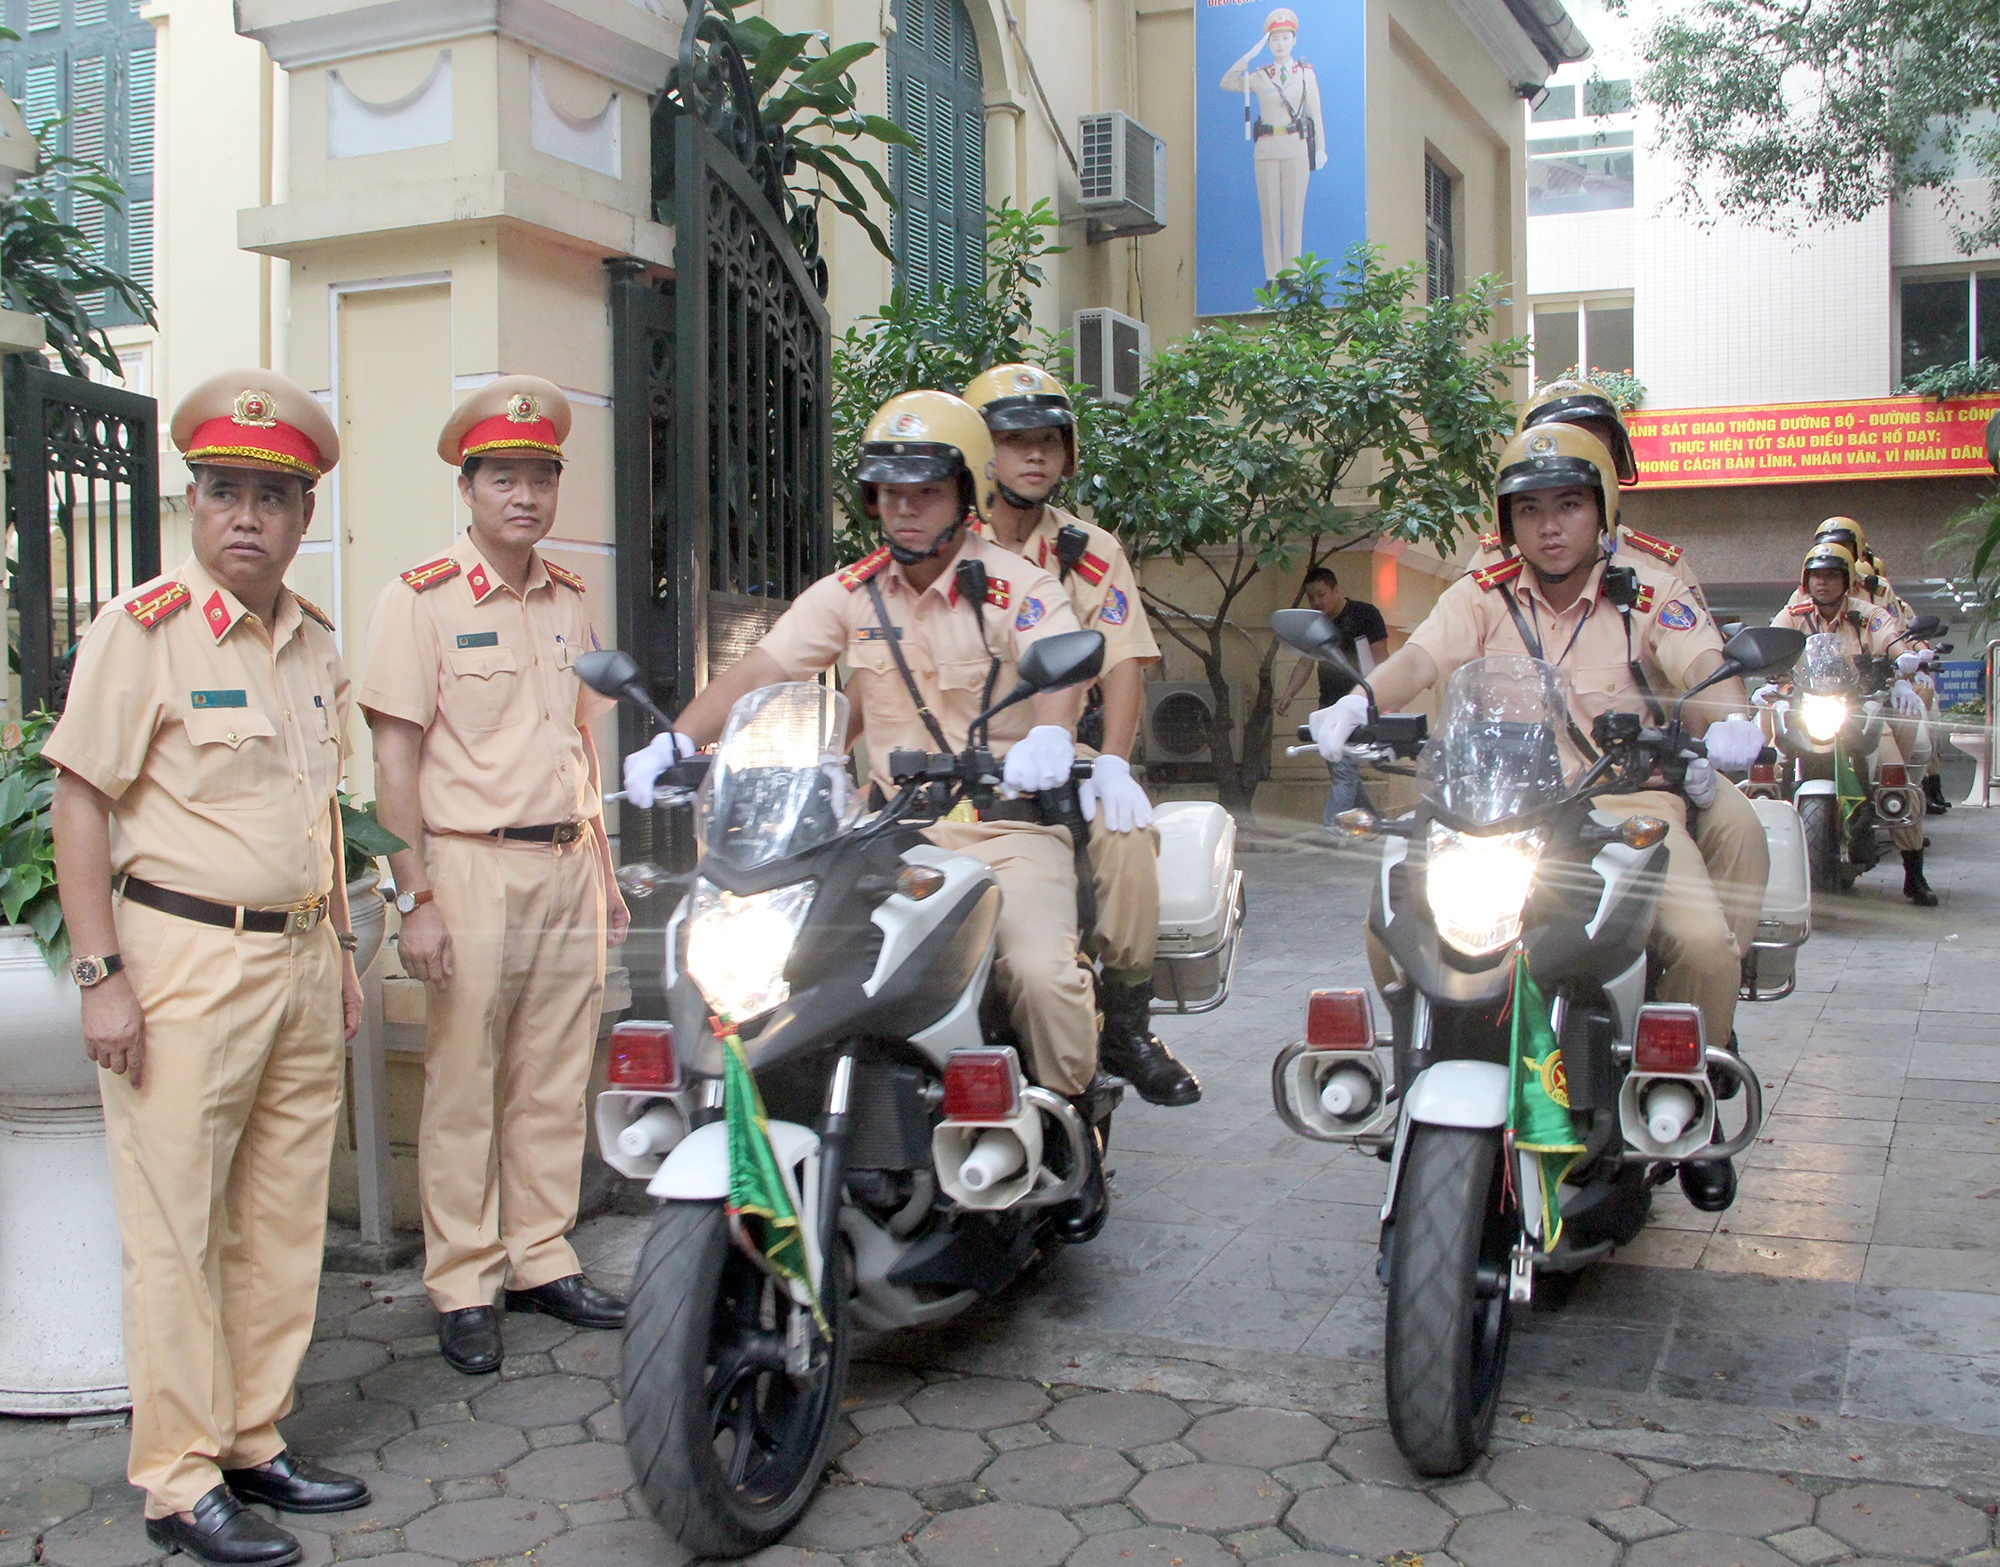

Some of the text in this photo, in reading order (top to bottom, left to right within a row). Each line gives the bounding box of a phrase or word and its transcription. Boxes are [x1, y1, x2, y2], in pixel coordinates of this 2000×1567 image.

[1627, 421, 1657, 437] ẢNH
[1661, 421, 1688, 436] SÁT
[1692, 421, 1725, 435] GIAO
[1729, 418, 1776, 433] THÔNG
[1780, 414, 1830, 431] ĐƯỜNG
[1834, 412, 1854, 430] BỘ
[1868, 409, 1920, 426] ĐƯỜNG
[1925, 407, 1954, 423] SẮT
[1669, 440, 1706, 455] THỰC
[1709, 437, 1743, 454] HIỆN
[1747, 434, 1773, 450] TỐT
[1776, 434, 1806, 449] SÁU
[1848, 430, 1878, 446] BÁC
[1683, 456, 1722, 471] CÁCH
[1725, 452, 1756, 470] BẢN
[1759, 455, 1797, 469] LĨNH,
[1801, 451, 1843, 467] NHÂN
[1847, 450, 1881, 465] VĂN,
[1885, 447, 1900, 463] VÌ
[1904, 445, 1947, 462] NHÂN
[1951, 444, 1983, 460] DÂN
